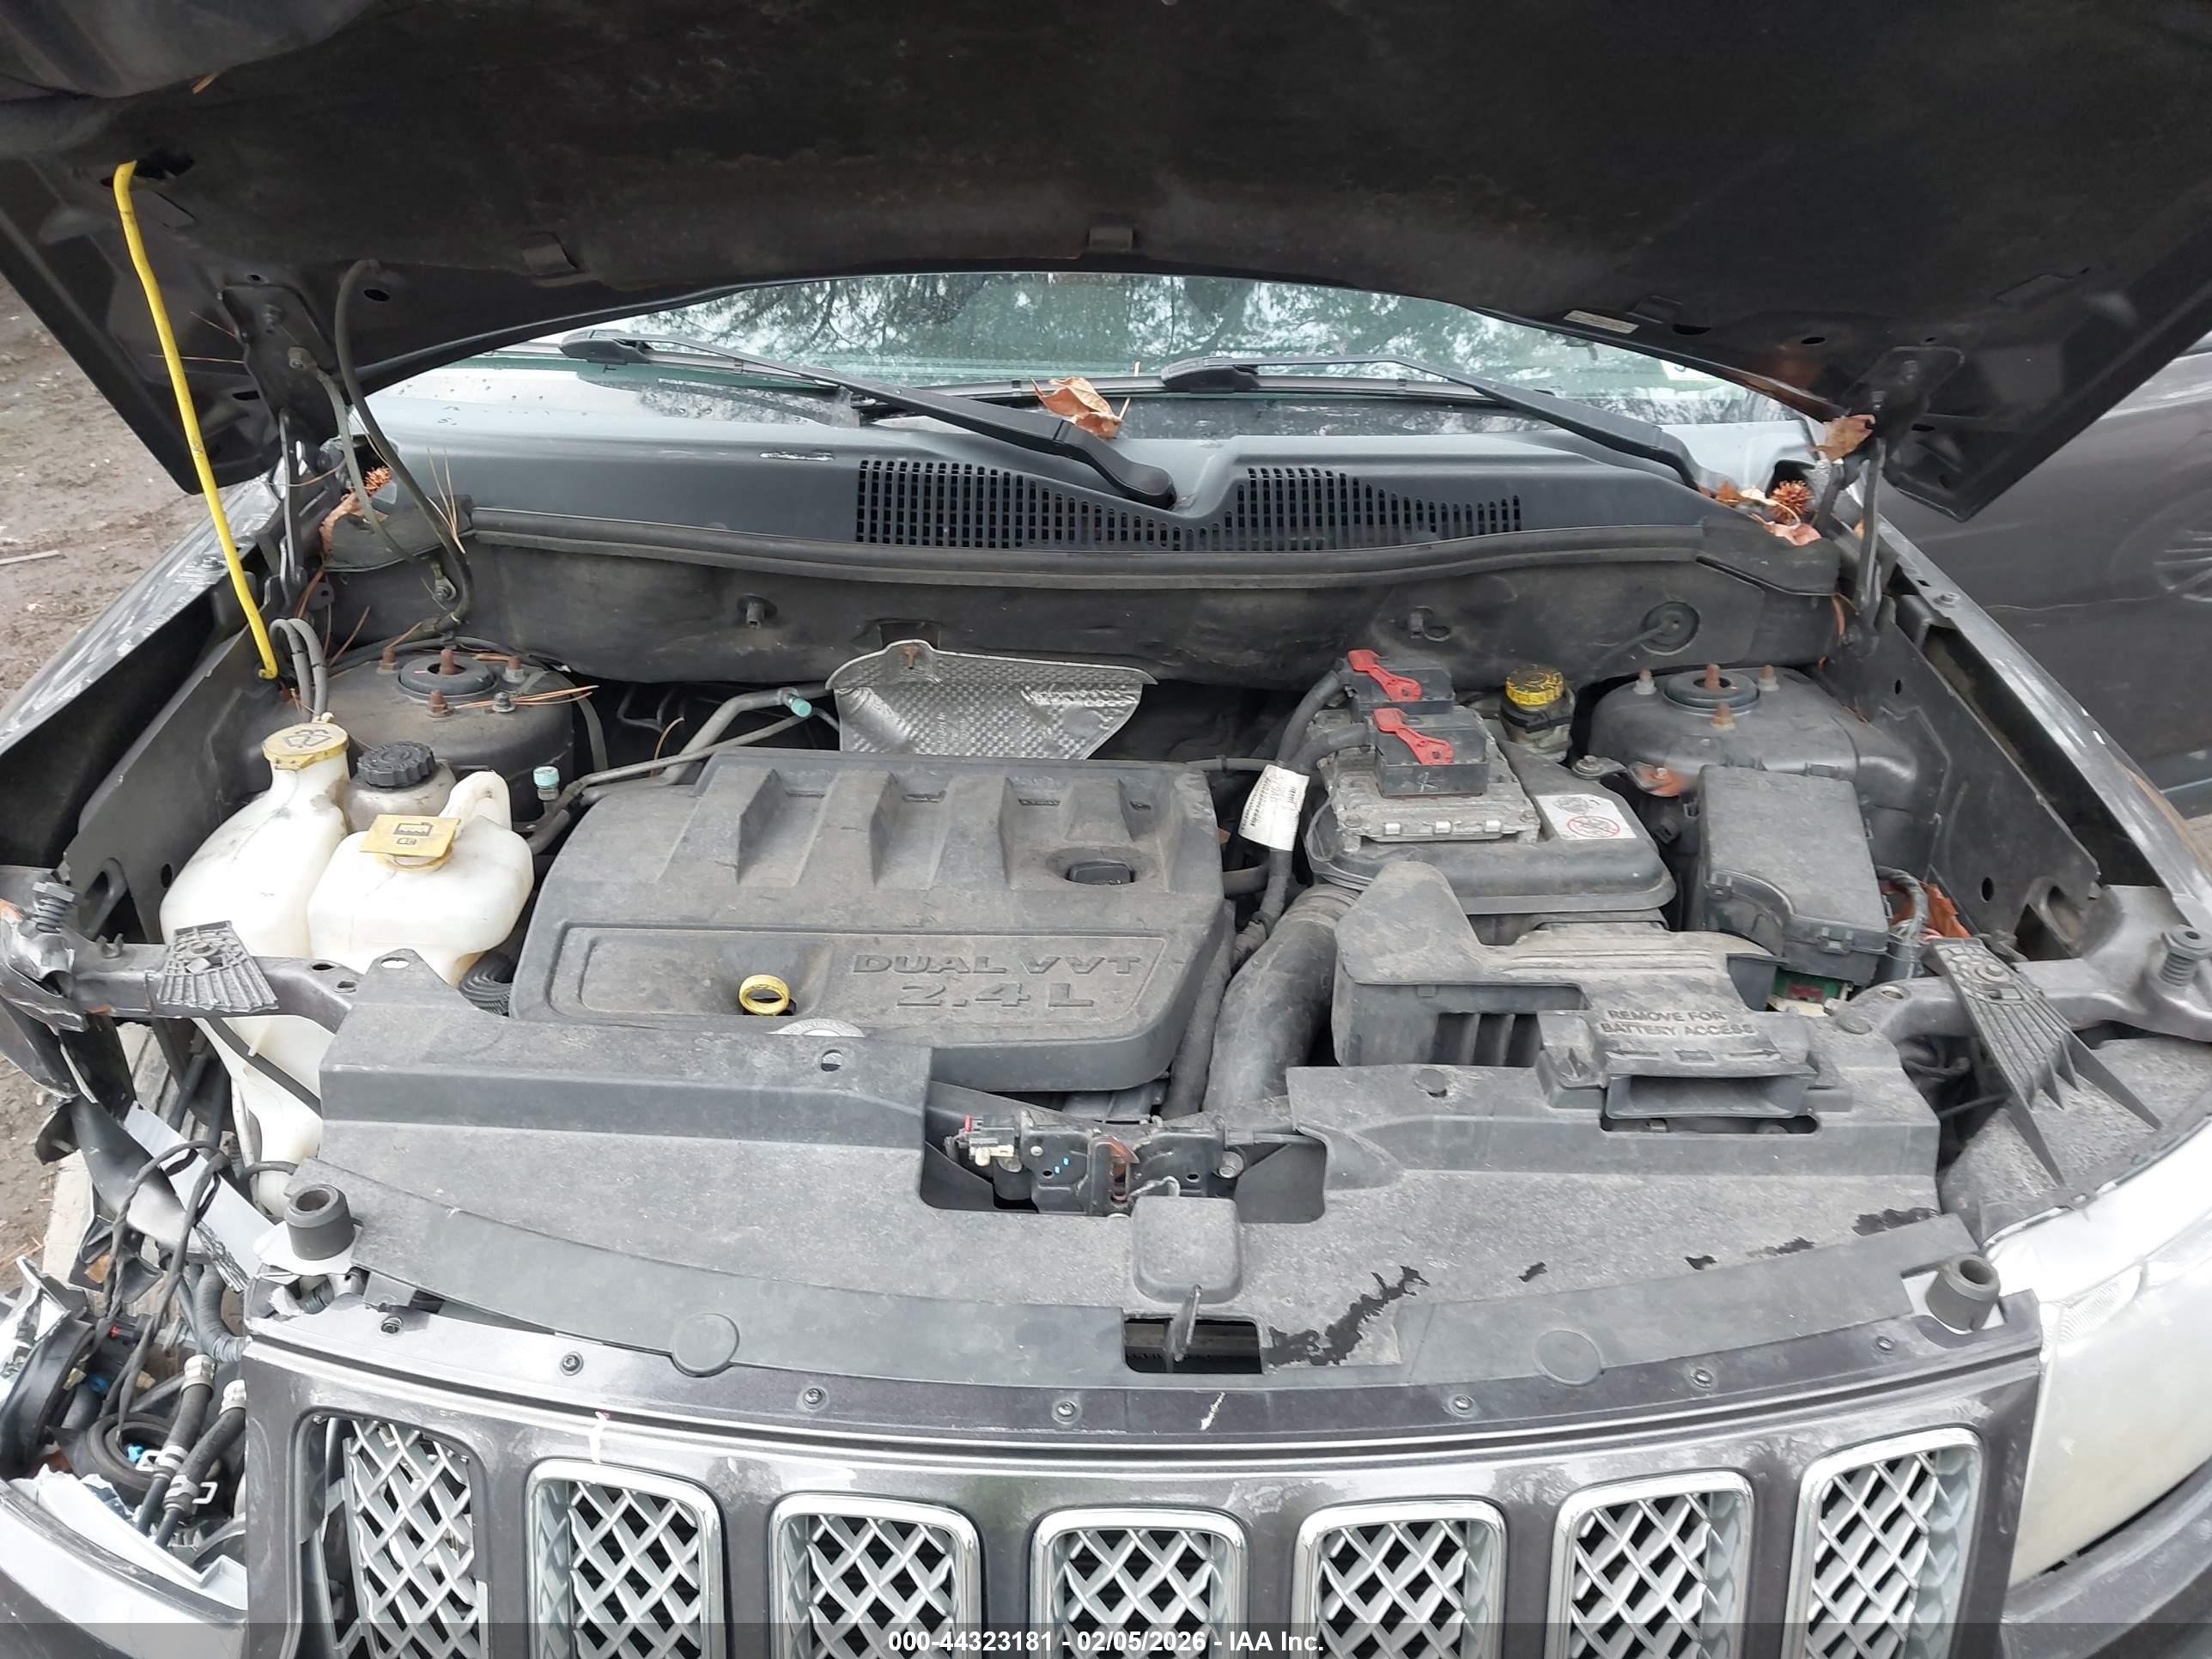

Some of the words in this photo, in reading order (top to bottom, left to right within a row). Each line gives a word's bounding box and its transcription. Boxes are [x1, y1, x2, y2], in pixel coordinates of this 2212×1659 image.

[853, 954, 1007, 975] DUAL
[1020, 955, 1141, 975] VVT
[1607, 1009, 1686, 1022] REMOVE
[1687, 1010, 1727, 1021] FOR
[1600, 1022, 1676, 1036] BATTERY
[1683, 1024, 1755, 1036] ACCESS
